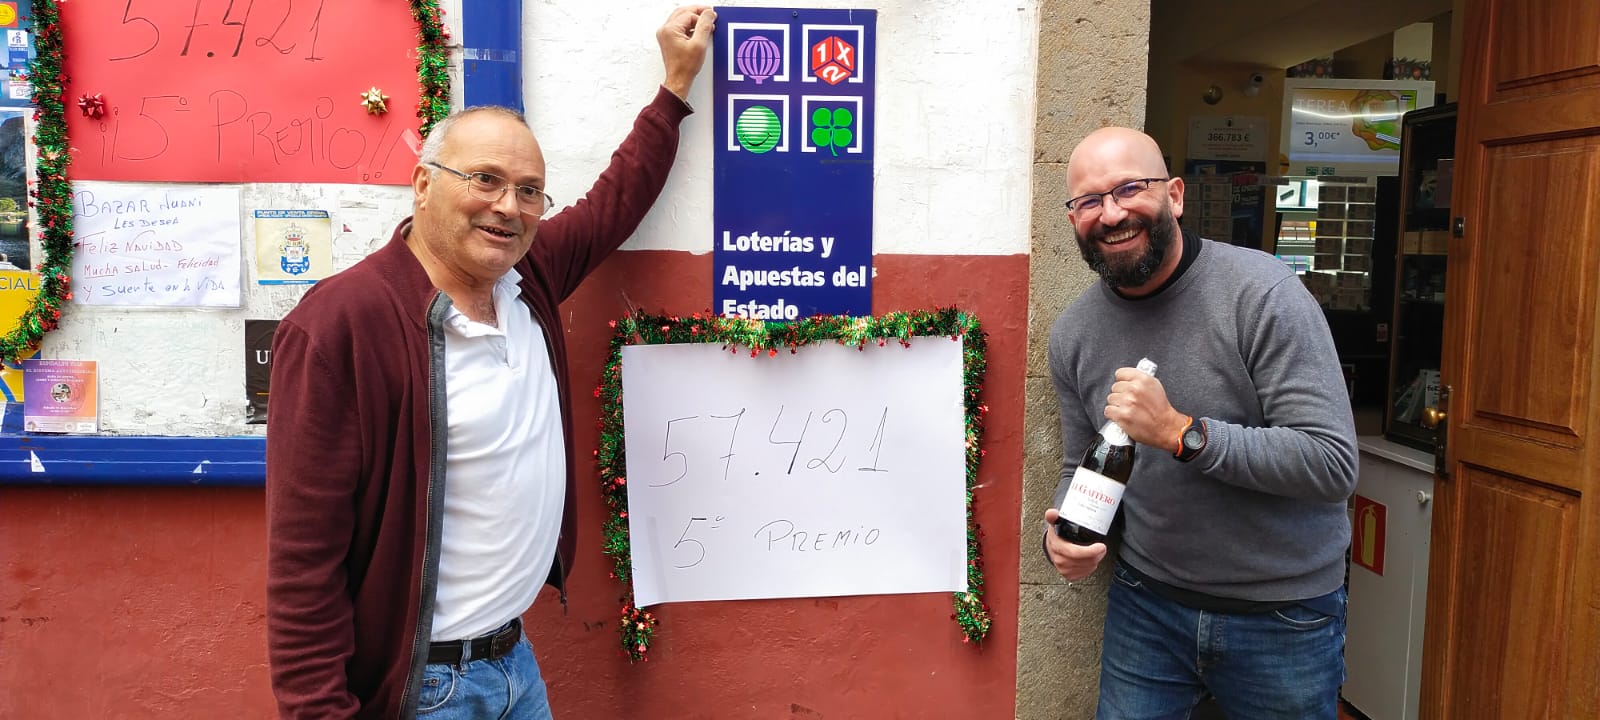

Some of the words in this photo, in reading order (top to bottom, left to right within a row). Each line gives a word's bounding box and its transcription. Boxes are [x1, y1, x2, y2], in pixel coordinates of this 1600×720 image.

[109, 0, 324, 60] 57.421
[74, 190, 150, 217] BAZAR
[114, 217, 134, 229] LES
[723, 231, 814, 252] Loterías
[821, 236, 834, 258] y
[722, 265, 825, 291] Apuestas
[832, 265, 866, 287] del
[723, 299, 799, 320] Estado
[649, 405, 888, 487] 57.421
[670, 515, 725, 568] 5º
